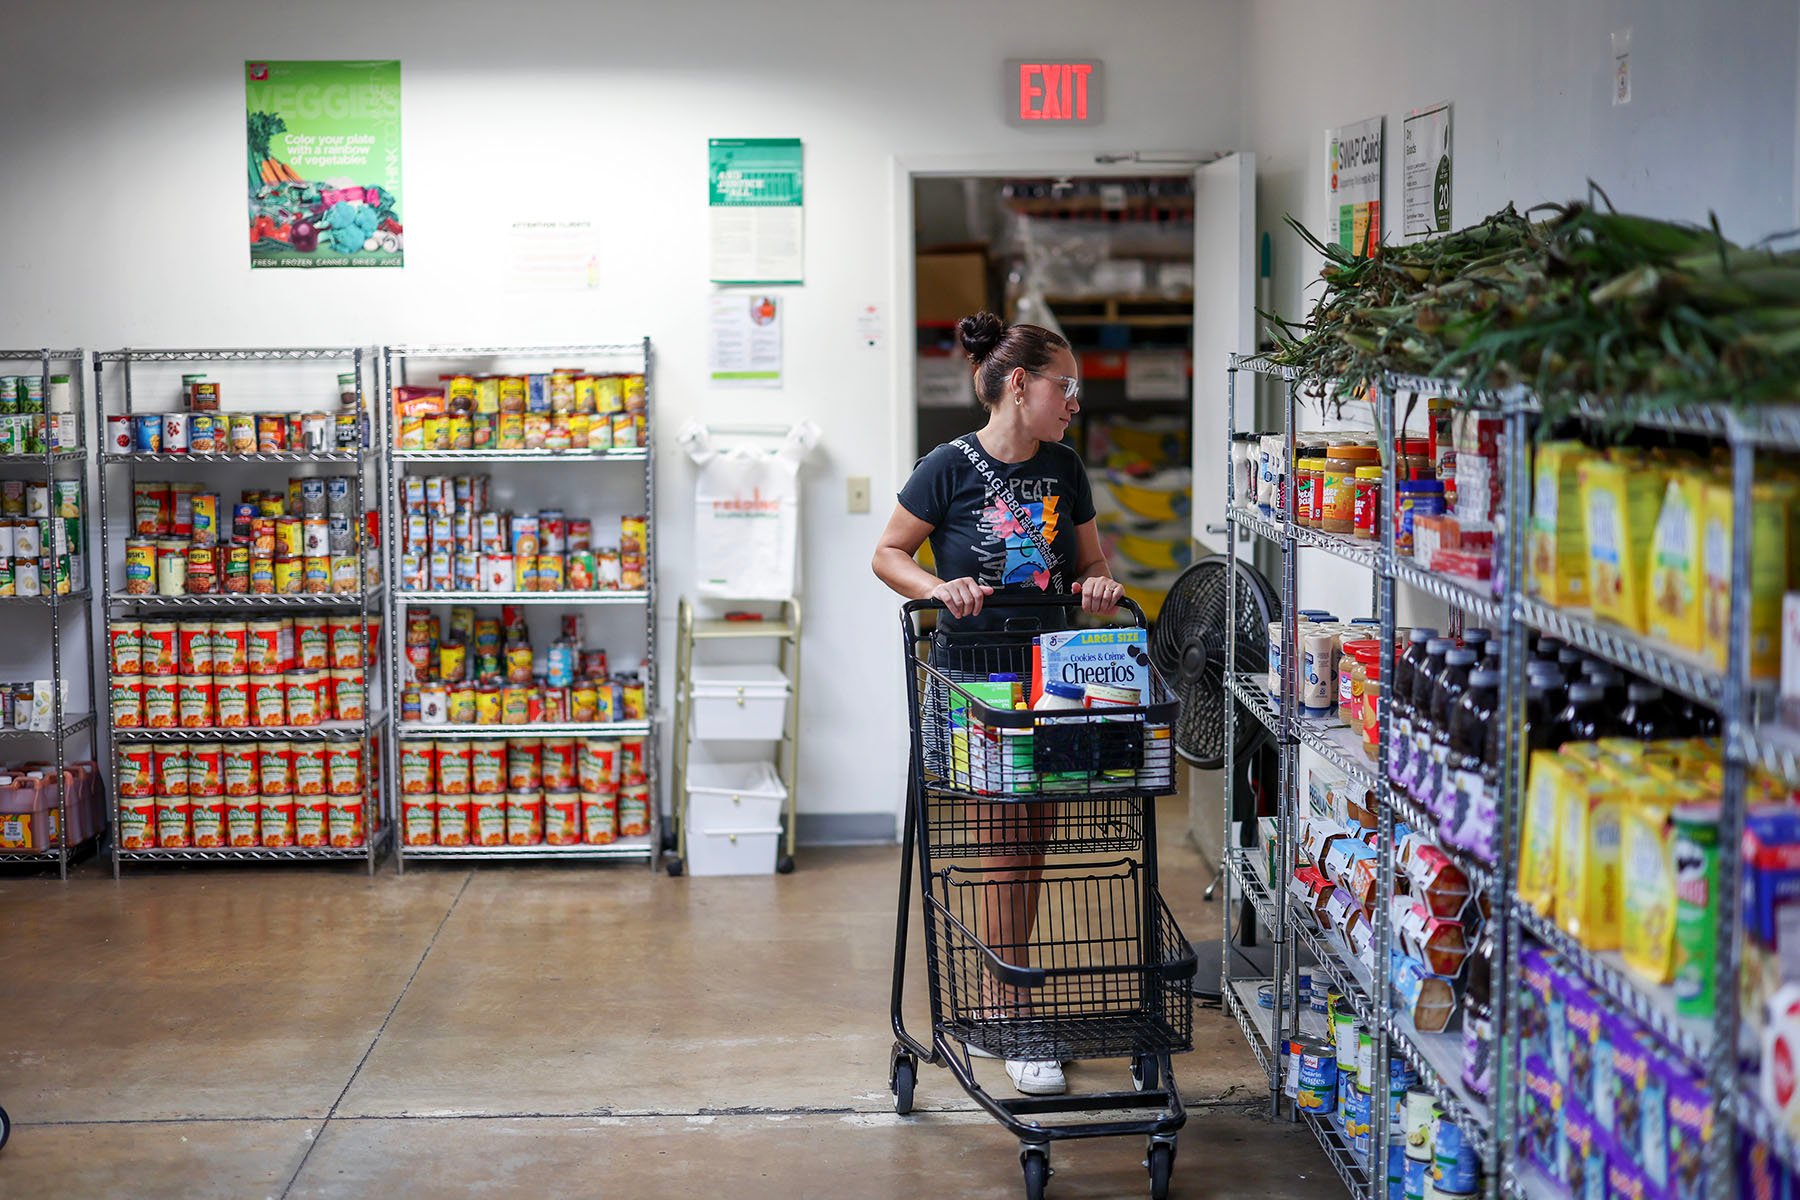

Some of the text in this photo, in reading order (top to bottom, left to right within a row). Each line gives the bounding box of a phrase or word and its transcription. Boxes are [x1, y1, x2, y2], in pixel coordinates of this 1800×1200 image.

[1020, 64, 1092, 119] EXIT
[250, 84, 398, 120] VEGGIES
[285, 134, 375, 148] Color your plate
[288, 144, 371, 155] with a rainbow
[291, 155, 367, 167] of vegetables
[1339, 133, 1380, 170] SWAP Guid
[1439, 184, 1449, 211] 20
[253, 258, 277, 267] FRESH
[281, 258, 313, 267] FROZEN
[316, 258, 348, 267] CANNED
[1009, 478, 1058, 502] PEAT
[1081, 633, 1115, 644] LARGE
[1117, 632, 1140, 643] SIZE
[1070, 653, 1097, 662] Cookies
[1104, 652, 1126, 661] Crème
[1062, 661, 1135, 685] Cheerios
